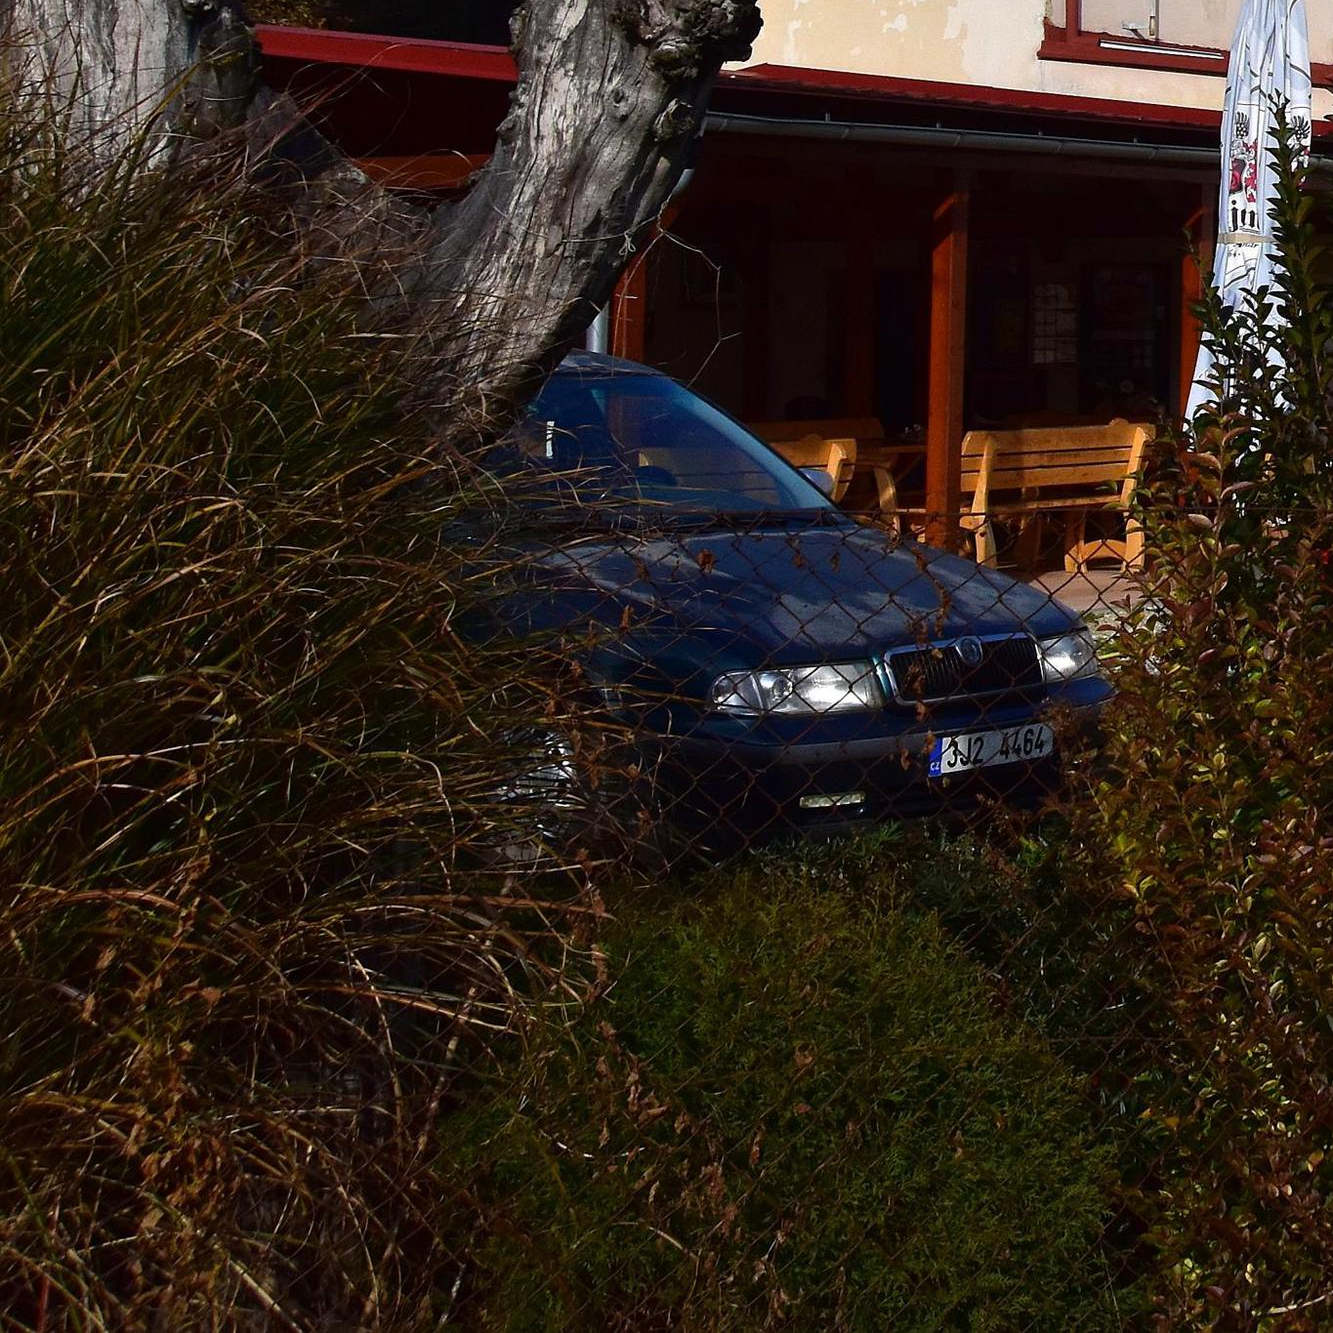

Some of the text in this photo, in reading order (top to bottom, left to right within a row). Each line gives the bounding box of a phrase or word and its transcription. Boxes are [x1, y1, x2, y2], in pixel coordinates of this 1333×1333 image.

[947, 725, 1045, 767] 3J2 4464
[929, 761, 940, 771] CZ
